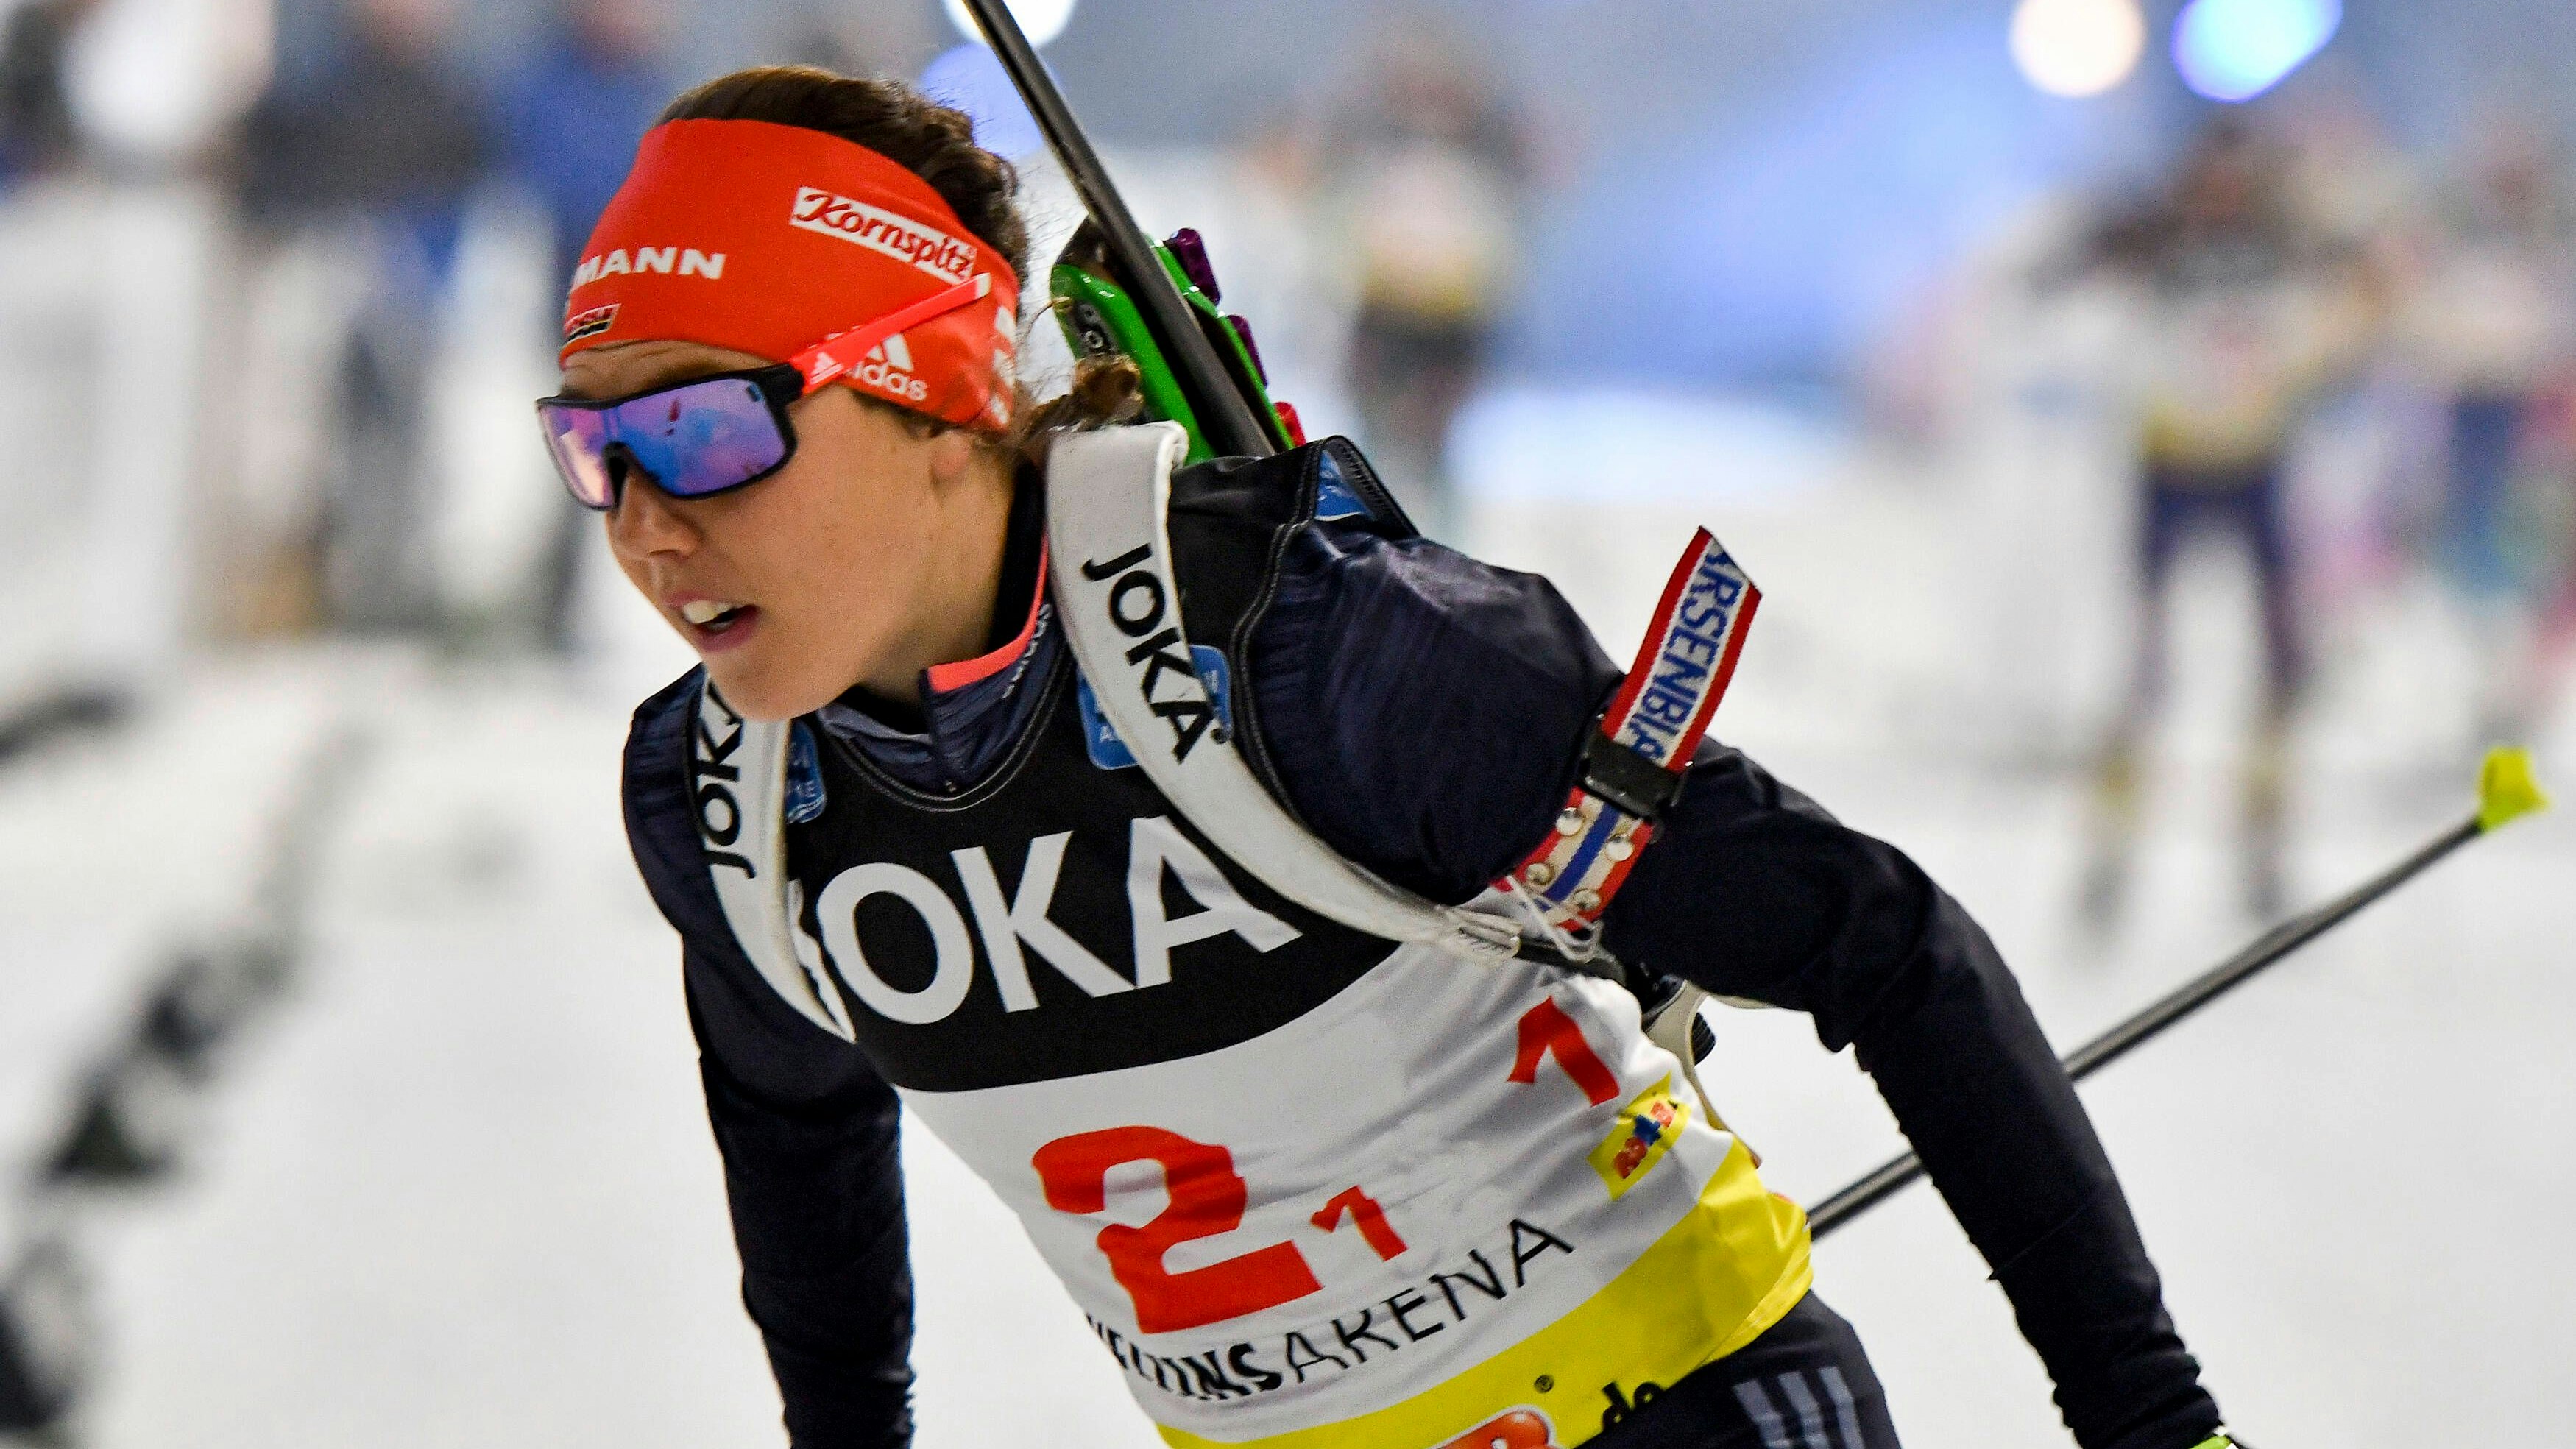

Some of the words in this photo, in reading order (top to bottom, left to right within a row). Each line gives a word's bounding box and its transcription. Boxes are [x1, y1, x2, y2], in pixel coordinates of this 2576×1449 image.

[793, 192, 971, 280] Kornspitz
[846, 358, 928, 402] idas
[1080, 542, 1217, 765] JOKA
[1507, 995, 1619, 1108] 1
[1031, 1125, 1324, 1334] 2
[1311, 1185, 1409, 1262] 1
